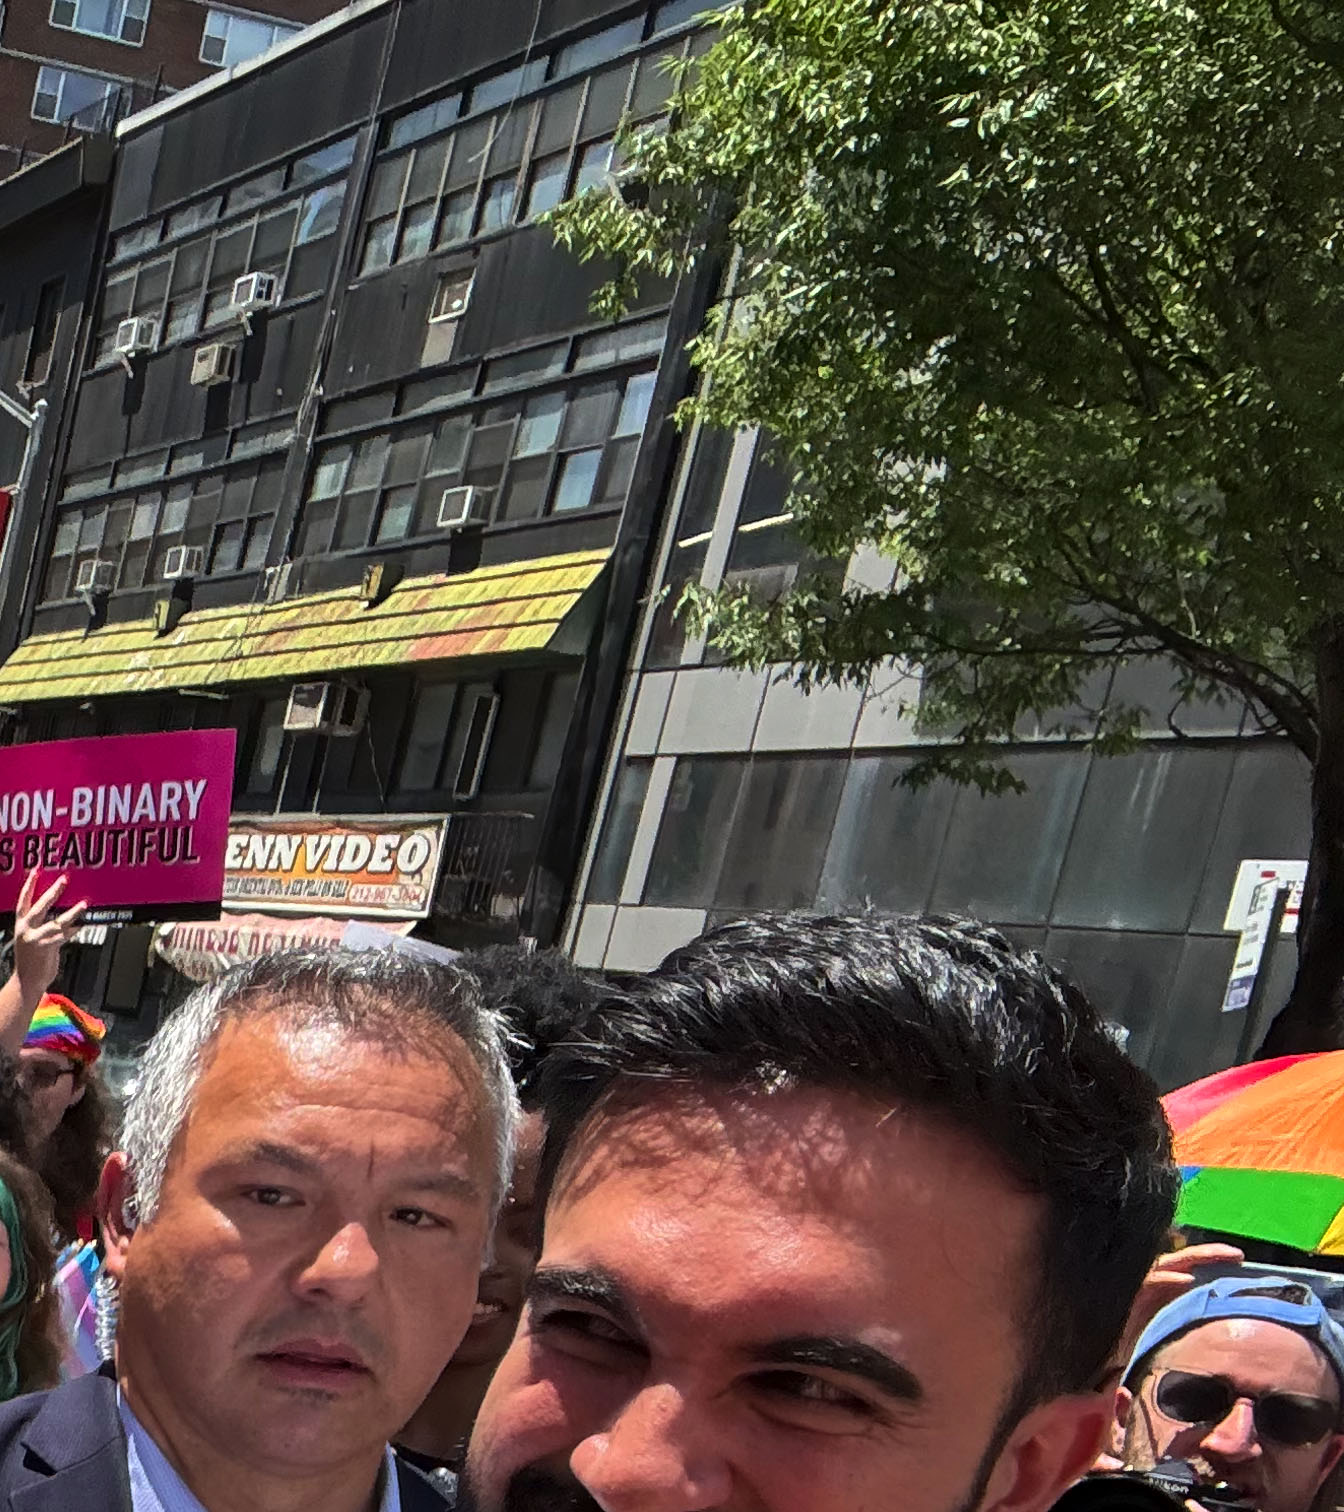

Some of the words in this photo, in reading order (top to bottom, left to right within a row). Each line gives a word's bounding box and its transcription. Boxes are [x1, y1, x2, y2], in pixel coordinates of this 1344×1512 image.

[23, 825, 201, 870] BEAUTIFUL
[224, 834, 303, 871] ENN
[305, 834, 430, 874] VIDEO
